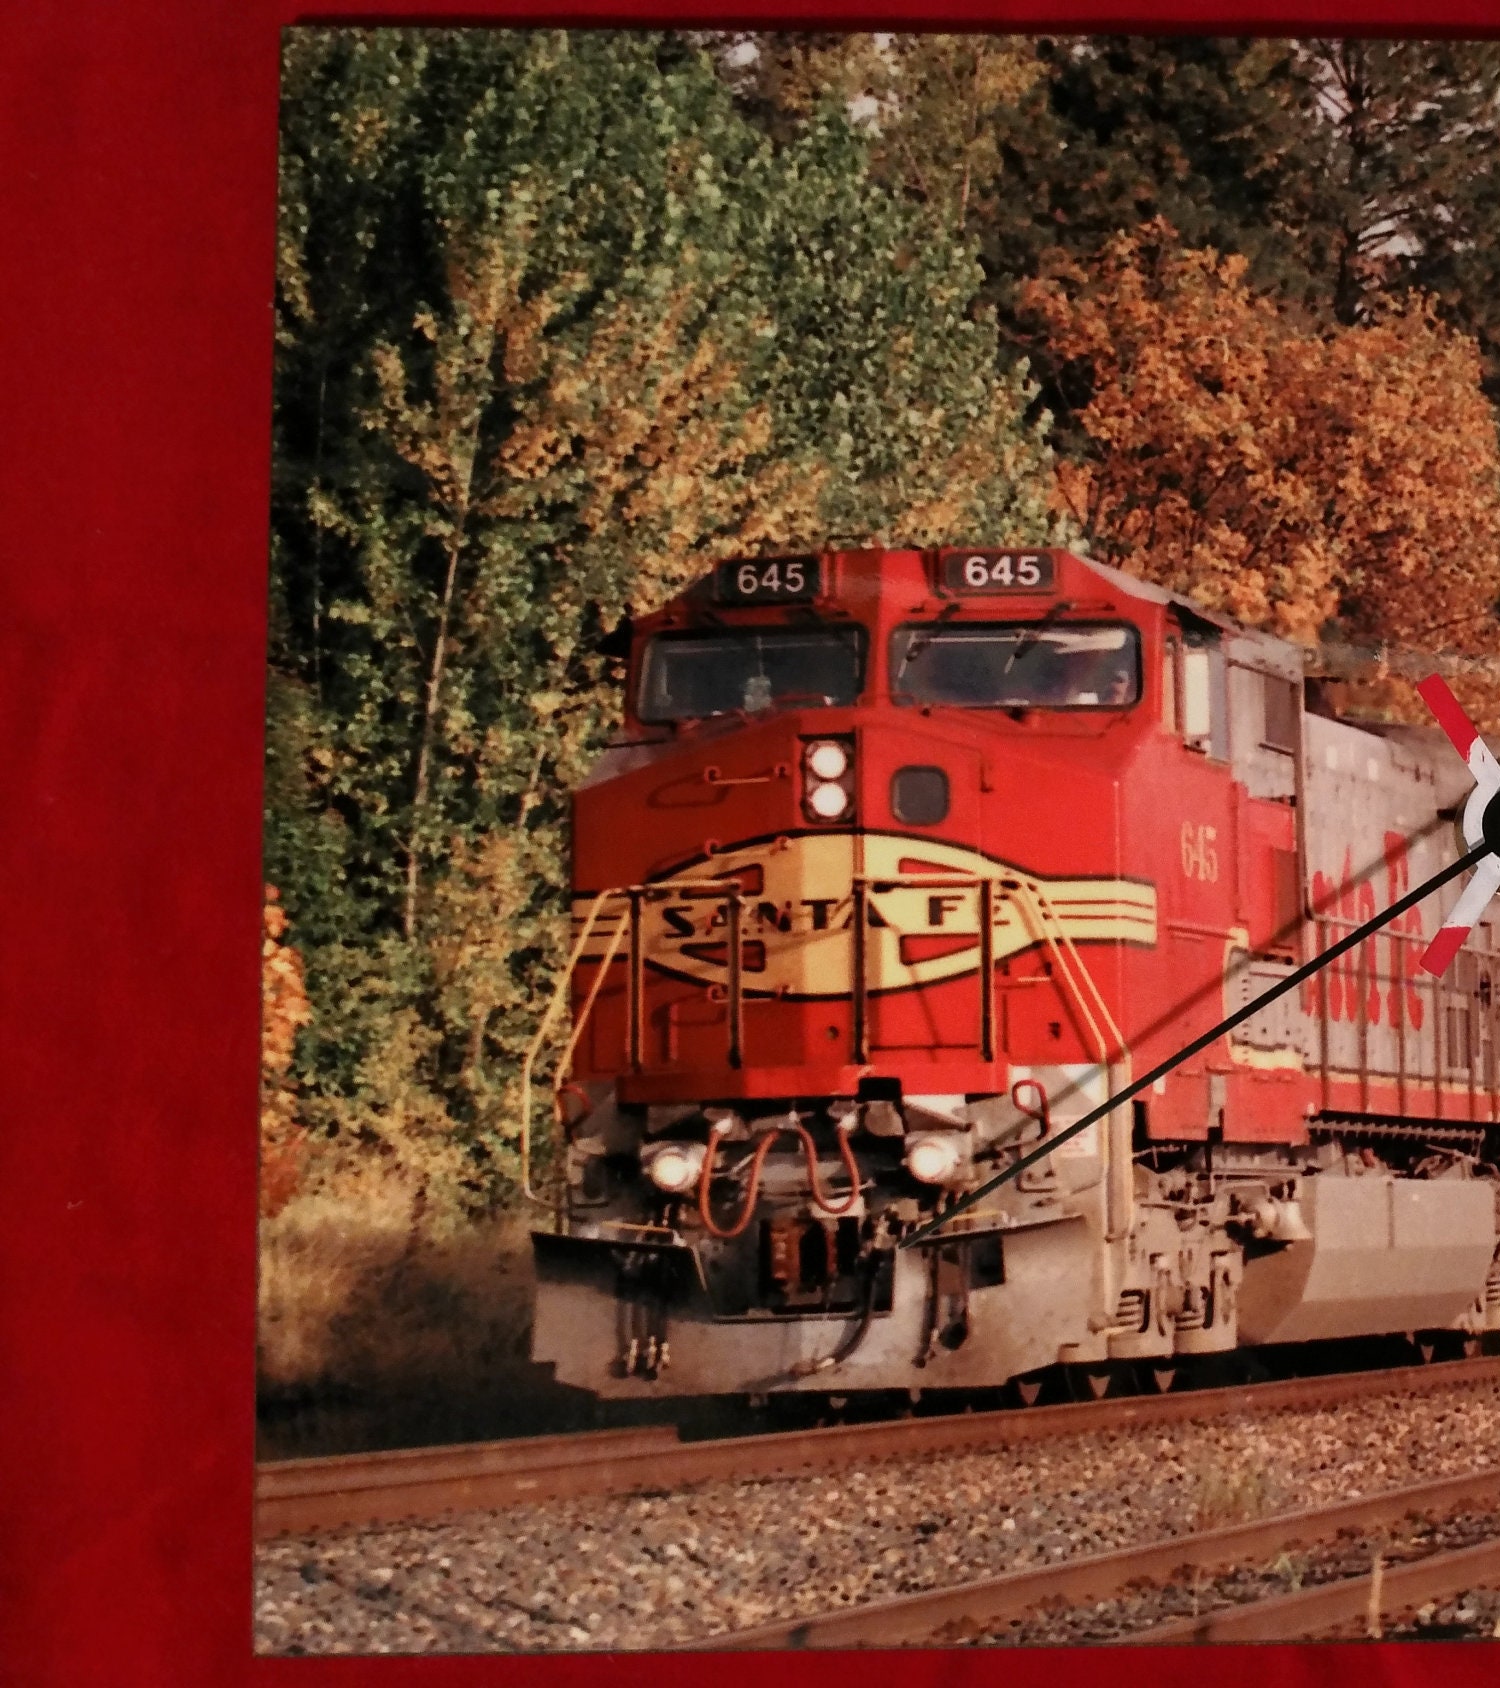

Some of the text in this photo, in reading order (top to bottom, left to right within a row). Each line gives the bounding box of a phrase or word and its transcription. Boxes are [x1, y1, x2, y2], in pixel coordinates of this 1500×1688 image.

[737, 562, 805, 595] 645
[962, 554, 1041, 588] 645
[1180, 820, 1219, 884] 645
